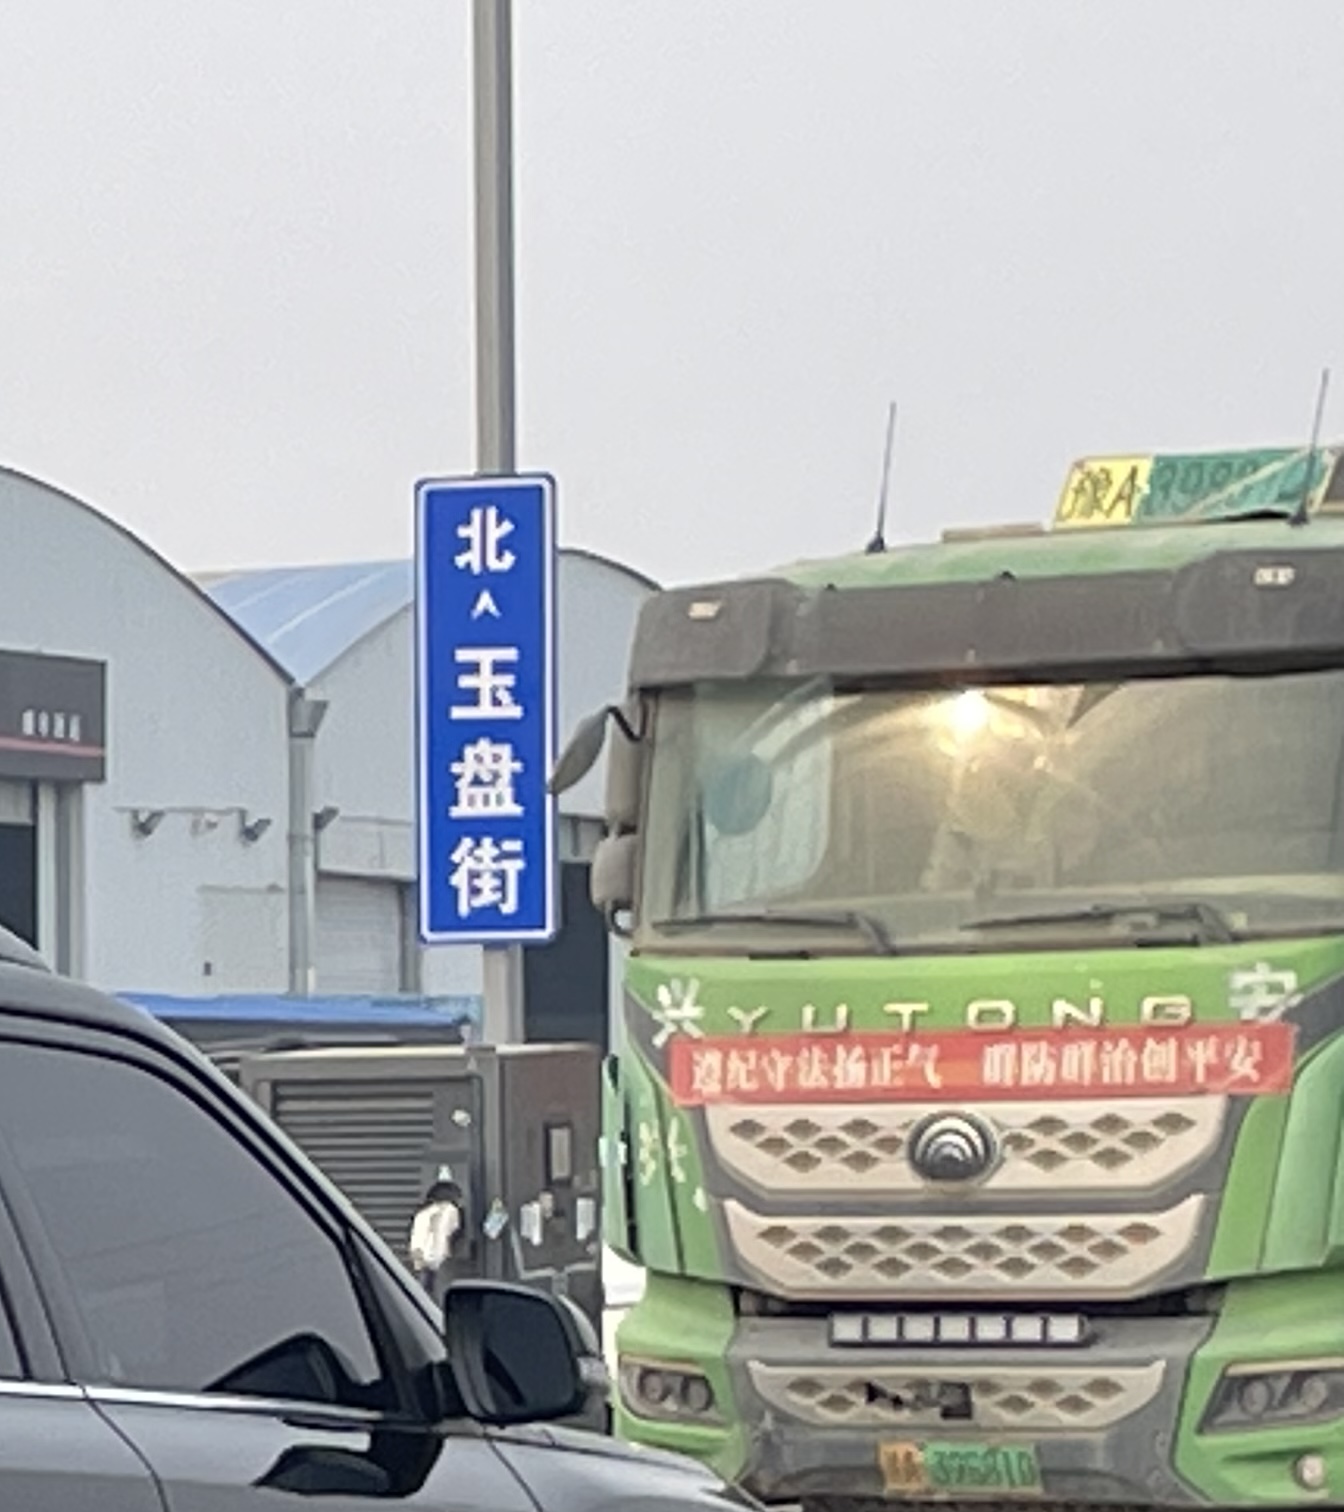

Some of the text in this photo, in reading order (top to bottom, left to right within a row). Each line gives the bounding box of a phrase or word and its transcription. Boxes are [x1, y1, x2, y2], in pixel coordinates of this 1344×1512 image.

[448, 505, 526, 918] 北 玉盘街
[726, 994, 1193, 1036] YUTONG
